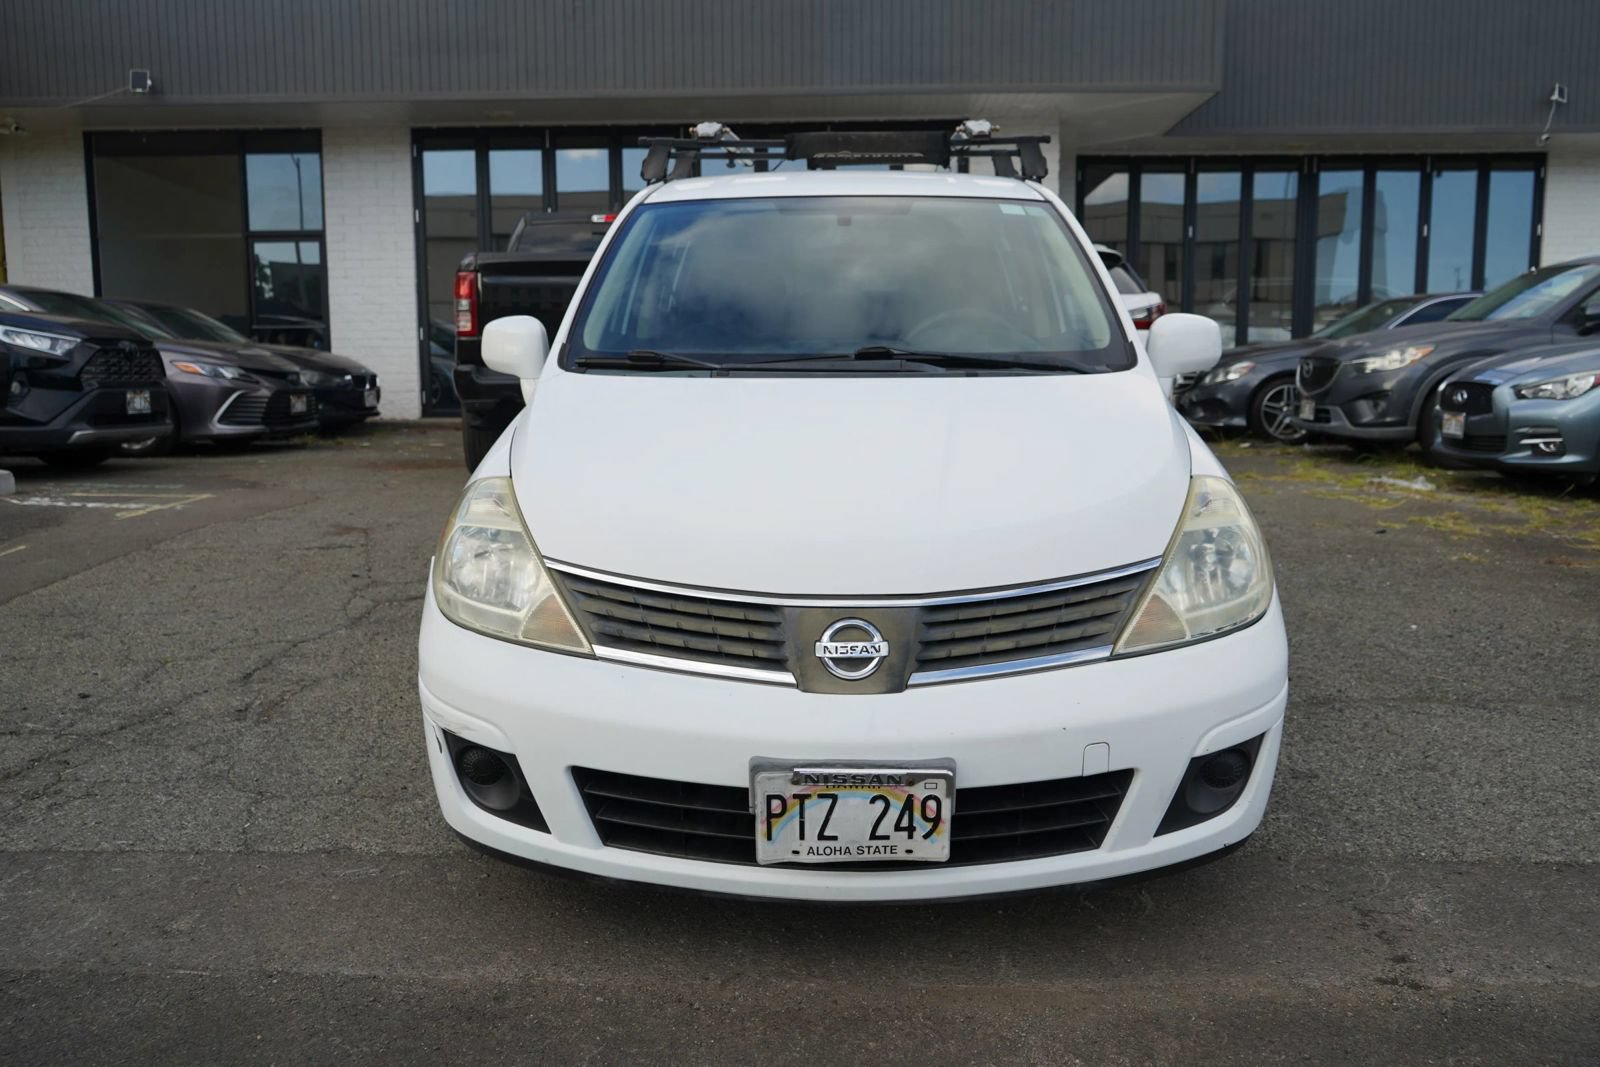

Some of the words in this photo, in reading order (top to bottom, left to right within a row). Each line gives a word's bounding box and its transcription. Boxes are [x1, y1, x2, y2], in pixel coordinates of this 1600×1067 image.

[823, 645, 881, 655] NISSAN
[805, 774, 902, 785] NISSAN
[766, 793, 839, 842] PTZ
[868, 793, 943, 842] 249
[806, 846, 852, 856] ALOHA
[856, 845, 898, 855] STATE
